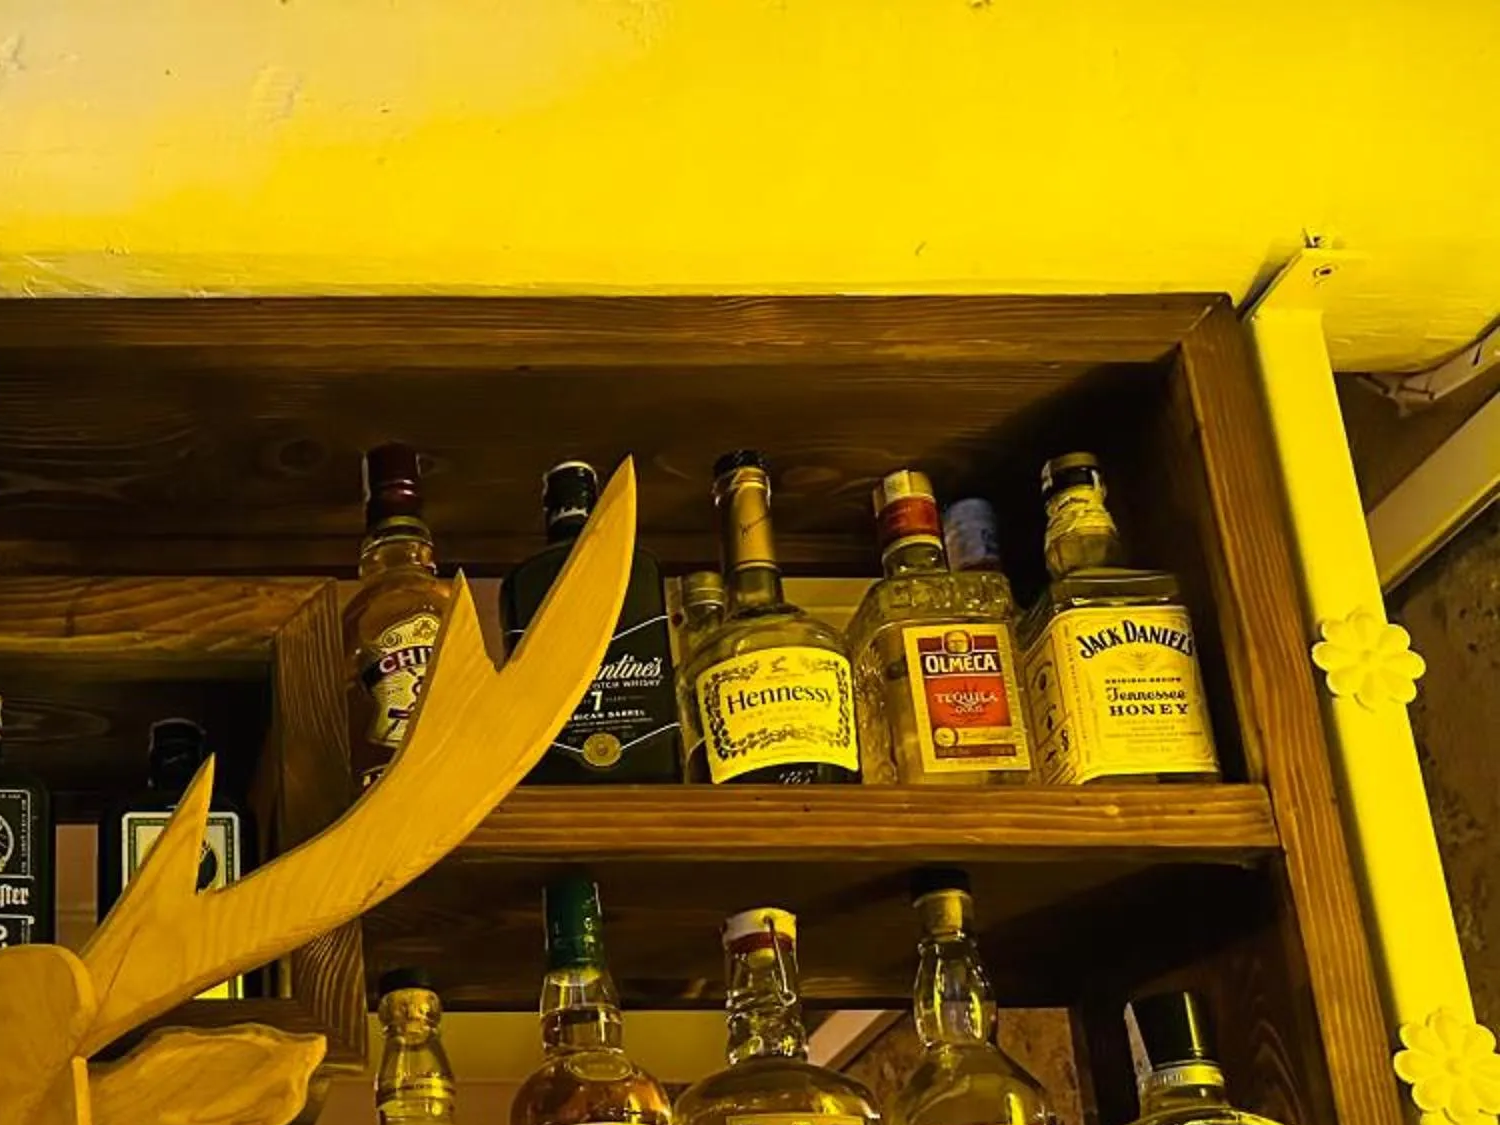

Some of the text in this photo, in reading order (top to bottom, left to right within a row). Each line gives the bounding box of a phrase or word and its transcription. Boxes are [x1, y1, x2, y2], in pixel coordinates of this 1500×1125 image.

[1076, 619, 1195, 659] JACK DANIEL'S
[924, 653, 998, 674] OLMECA
[590, 690, 603, 712] 7
[726, 684, 834, 715] Hennessy
[1105, 686, 1187, 703] Tennessee
[1109, 703, 1189, 718] HONEY
